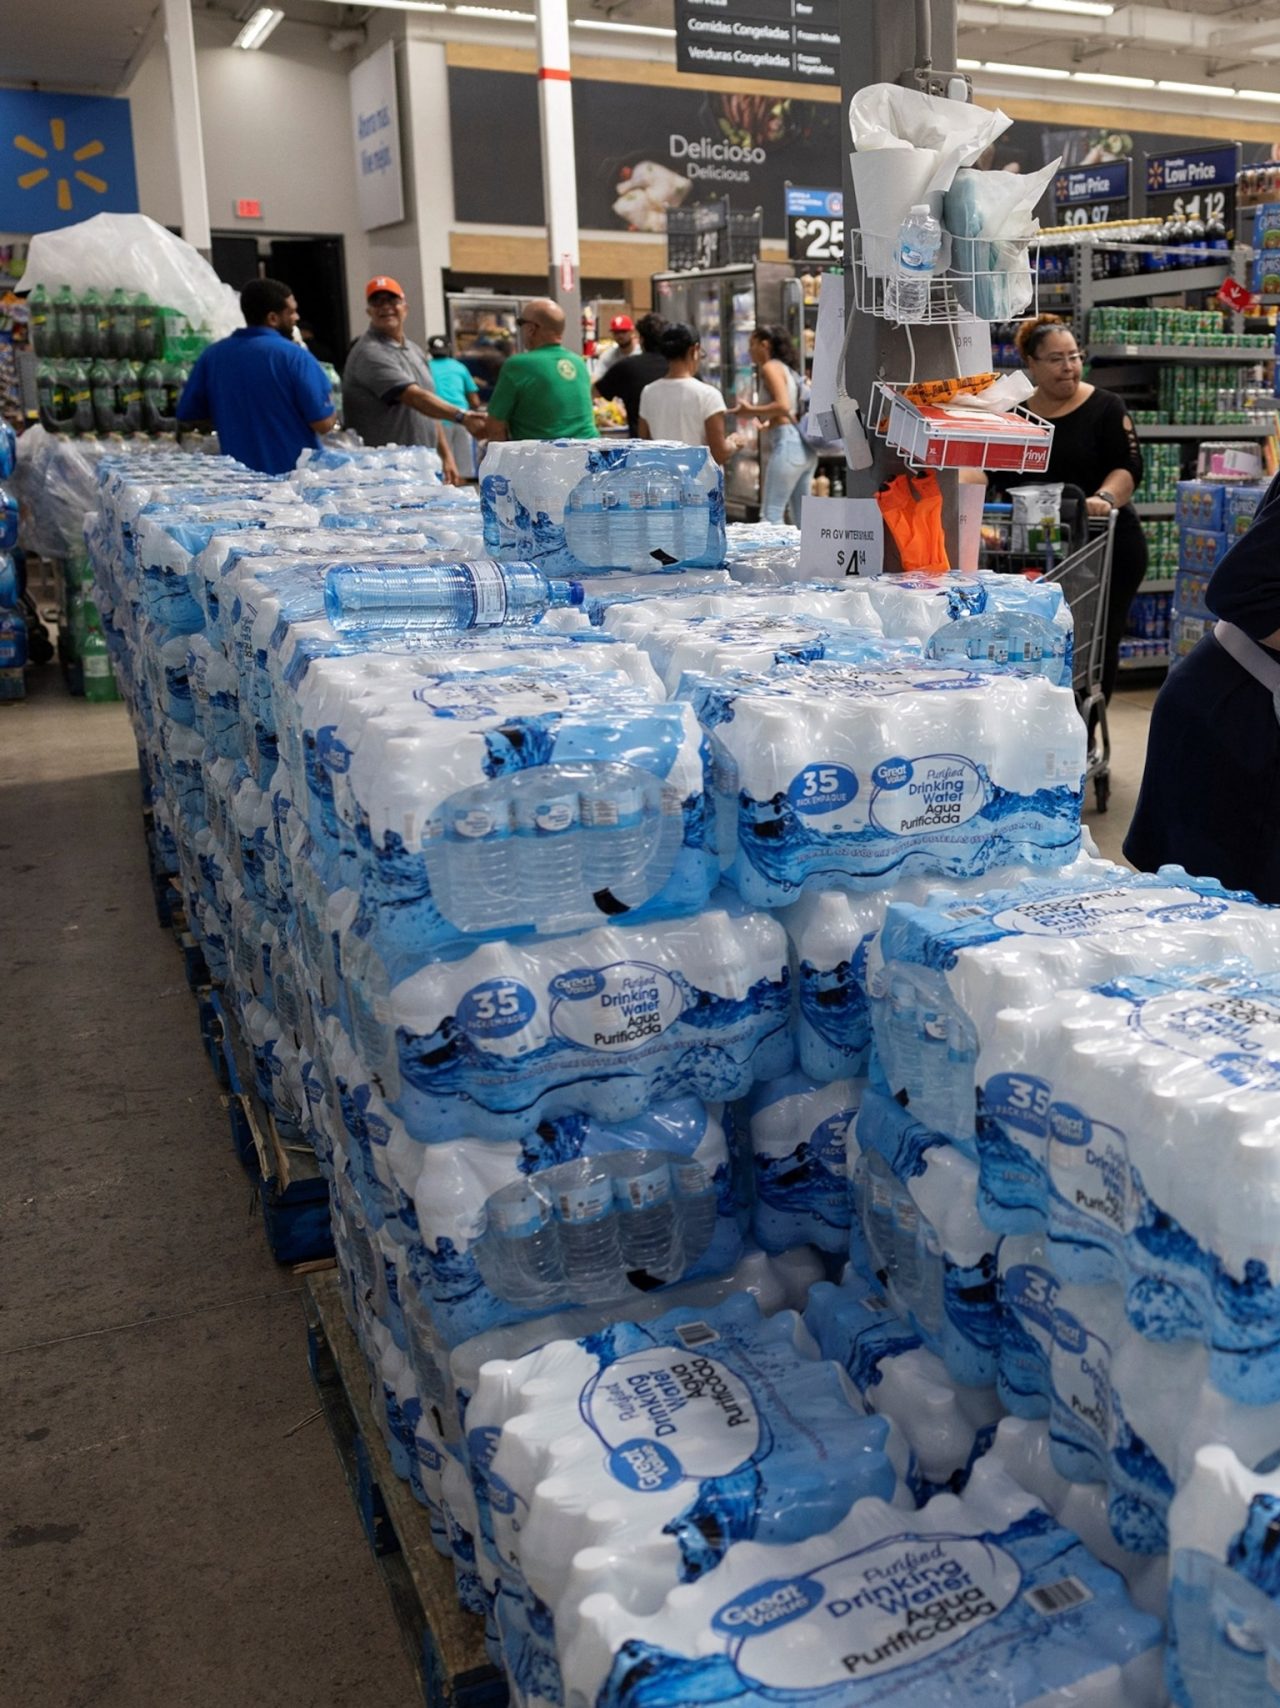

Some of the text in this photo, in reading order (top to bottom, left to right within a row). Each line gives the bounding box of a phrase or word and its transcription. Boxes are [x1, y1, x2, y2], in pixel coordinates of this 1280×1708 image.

[688, 18, 732, 34] Comidas
[732, 22, 790, 40] Congeladas
[688, 46, 790, 67] Verduras Congeladas
[669, 134, 766, 164] Delicioso
[687, 163, 750, 182] Delicious
[1165, 163, 1215, 183] Low Price
[1068, 176, 1110, 195] Low Price
[821, 528, 831, 540] PR
[833, 529, 843, 540] GV
[877, 764, 908, 778] Great
[927, 765, 966, 780] Purified
[802, 769, 839, 796] 35
[909, 778, 964, 796] Drinking
[922, 791, 963, 805] Water
[925, 802, 961, 816] Agua
[901, 813, 961, 832] Purificada
[554, 975, 596, 990] Great
[472, 987, 520, 1019] 35
[601, 987, 659, 1008] Drinking
[620, 1000, 660, 1017] Water
[627, 1012, 660, 1029] Agua
[594, 1023, 661, 1046] Purificada
[1008, 1078, 1049, 1116] 35
[648, 1369, 688, 1414] Water
[670, 1362, 707, 1399] Agua
[691, 1358, 750, 1427] Purificada
[627, 1374, 677, 1437] Drinking
[620, 1447, 662, 1489] Great
[864, 1542, 946, 1584] Purified
[825, 1558, 963, 1619] Drinking
[877, 1572, 974, 1617] Water
[720, 1584, 803, 1626] Great
[904, 1585, 986, 1627] Agua
[842, 1600, 998, 1674] Purificada
